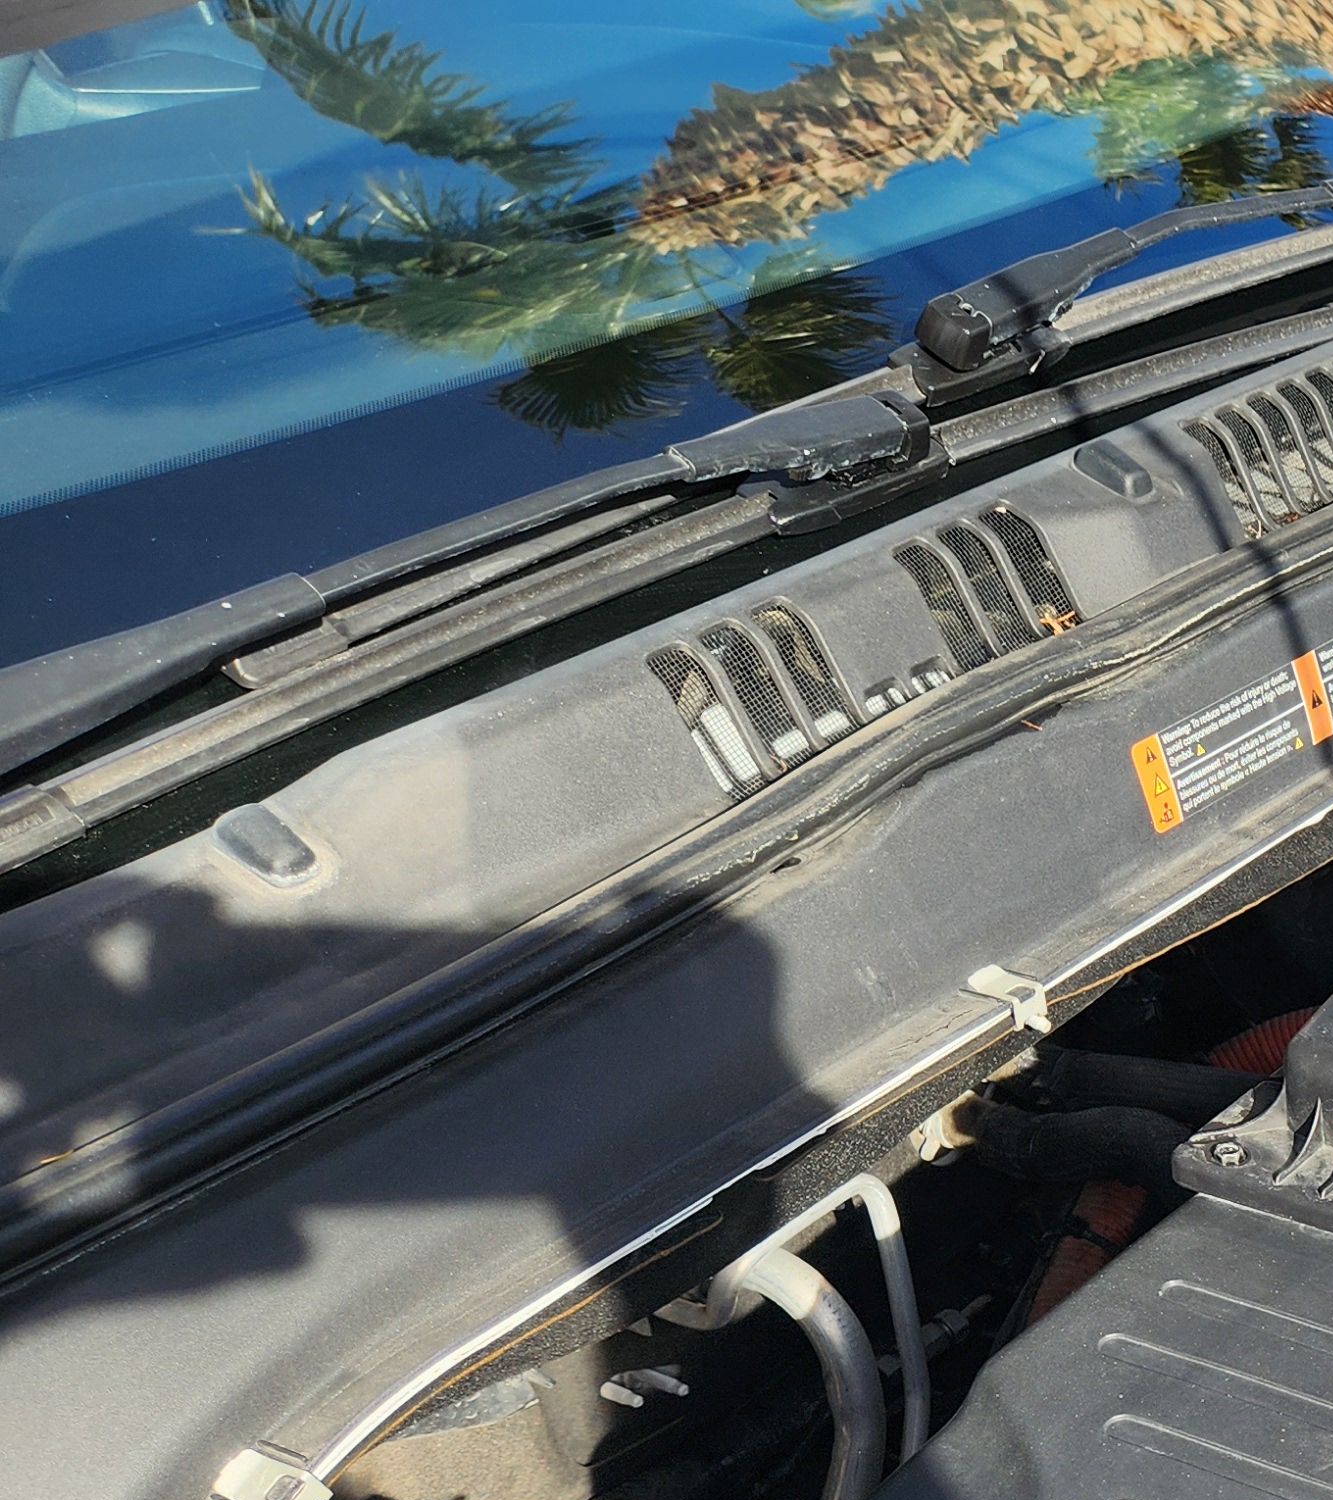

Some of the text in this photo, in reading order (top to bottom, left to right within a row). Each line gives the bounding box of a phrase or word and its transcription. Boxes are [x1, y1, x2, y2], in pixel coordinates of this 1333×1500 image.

[1161, 722, 1191, 744] Warning:
[1190, 718, 1199, 728] To
[1199, 707, 1220, 724] reduce
[1219, 701, 1231, 713] the
[1229, 696, 1241, 707] risk
[1240, 692, 1248, 702] of
[1247, 684, 1263, 698] injury
[1263, 680, 1270, 690] or
[1164, 679, 1297, 756] avoid components marked with the High Voltage
[1176, 758, 1221, 789] Avertissement
[1224, 748, 1239, 762] Pour
[1258, 733, 1265, 743] le
[1264, 724, 1282, 739] risque
[1282, 719, 1290, 730] de
[1179, 778, 1208, 801] blessures
[1208, 773, 1217, 784] ou
[1216, 768, 1225, 779] de
[1256, 745, 1266, 757] les
